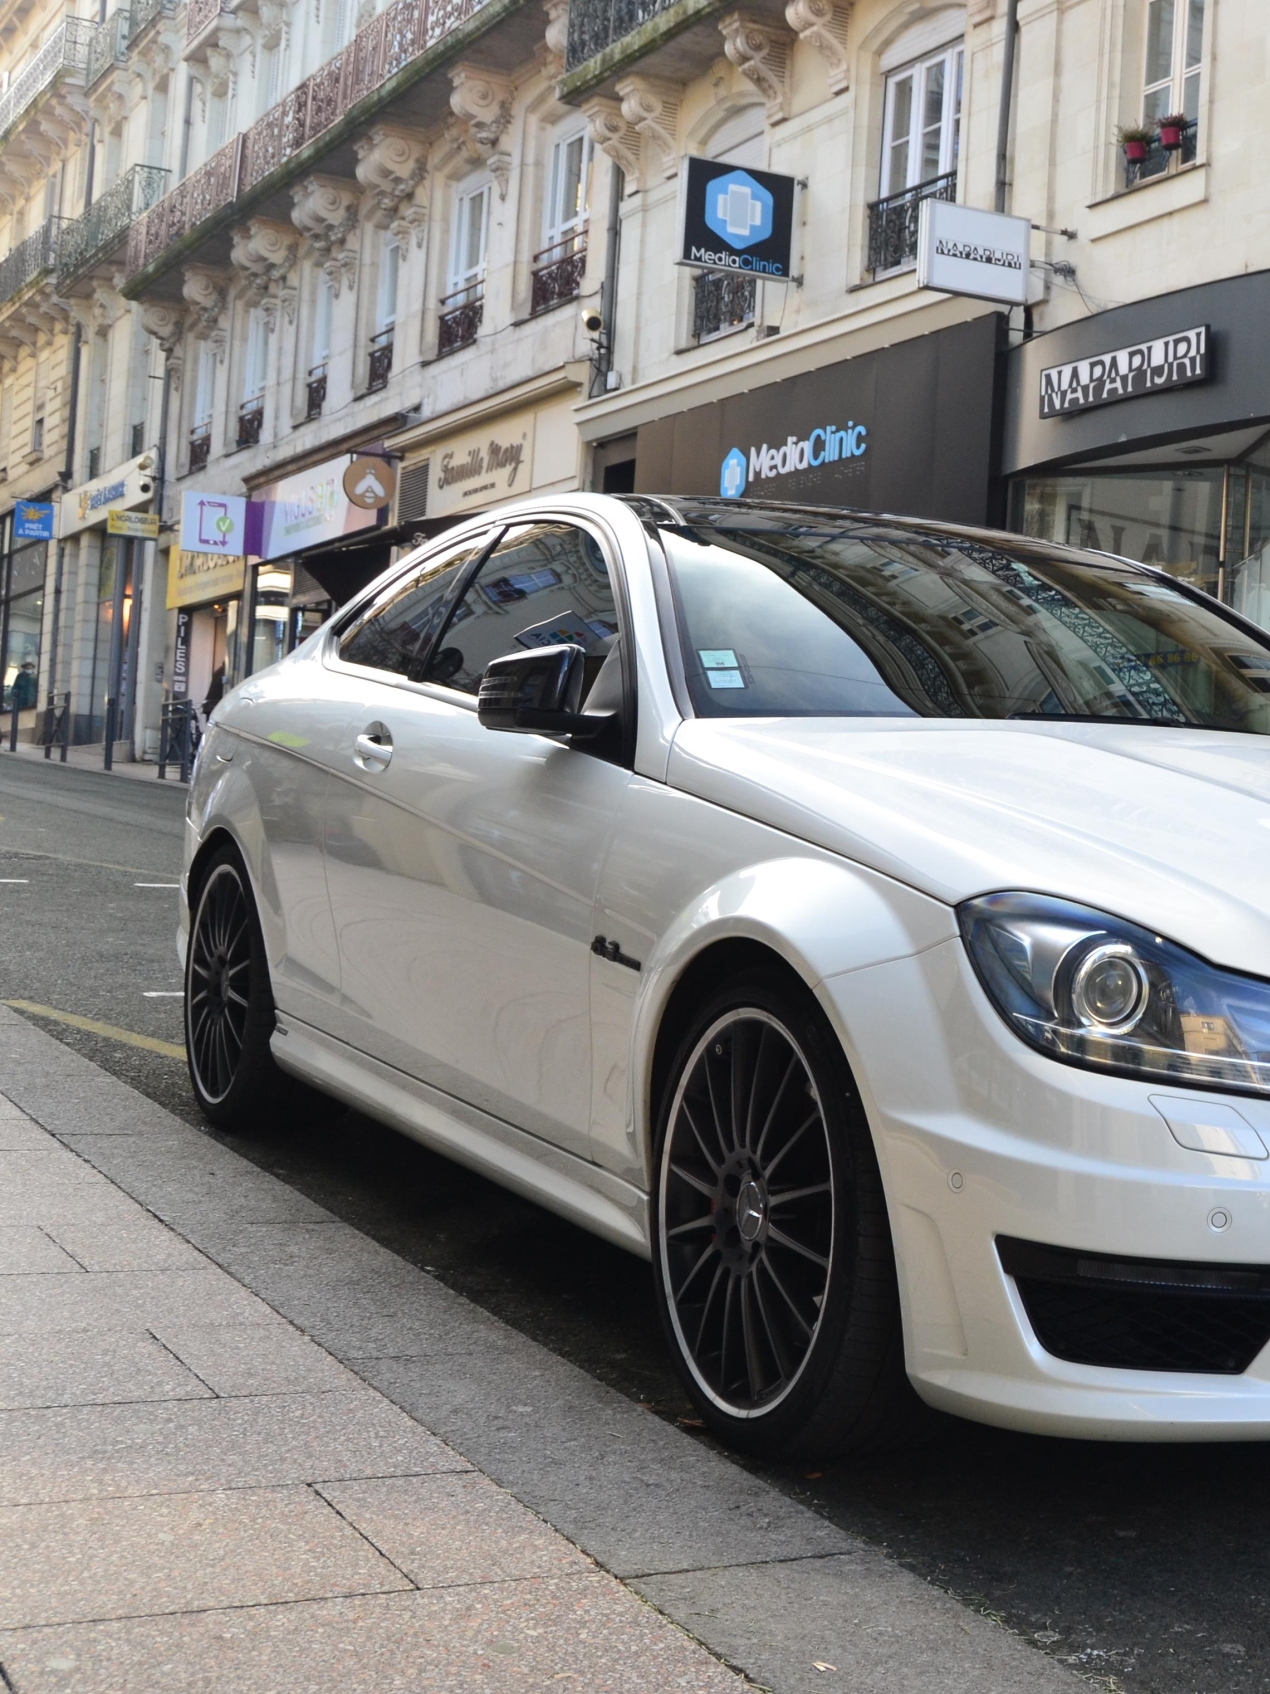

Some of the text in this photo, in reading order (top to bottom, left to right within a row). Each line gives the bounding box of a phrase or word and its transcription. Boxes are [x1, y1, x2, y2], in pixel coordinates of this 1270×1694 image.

[691, 246, 782, 275] MediaClinic
[1043, 332, 1203, 413] NAPAPIJRI
[748, 421, 867, 482] MediaClinic
[176, 614, 188, 673] PILES
